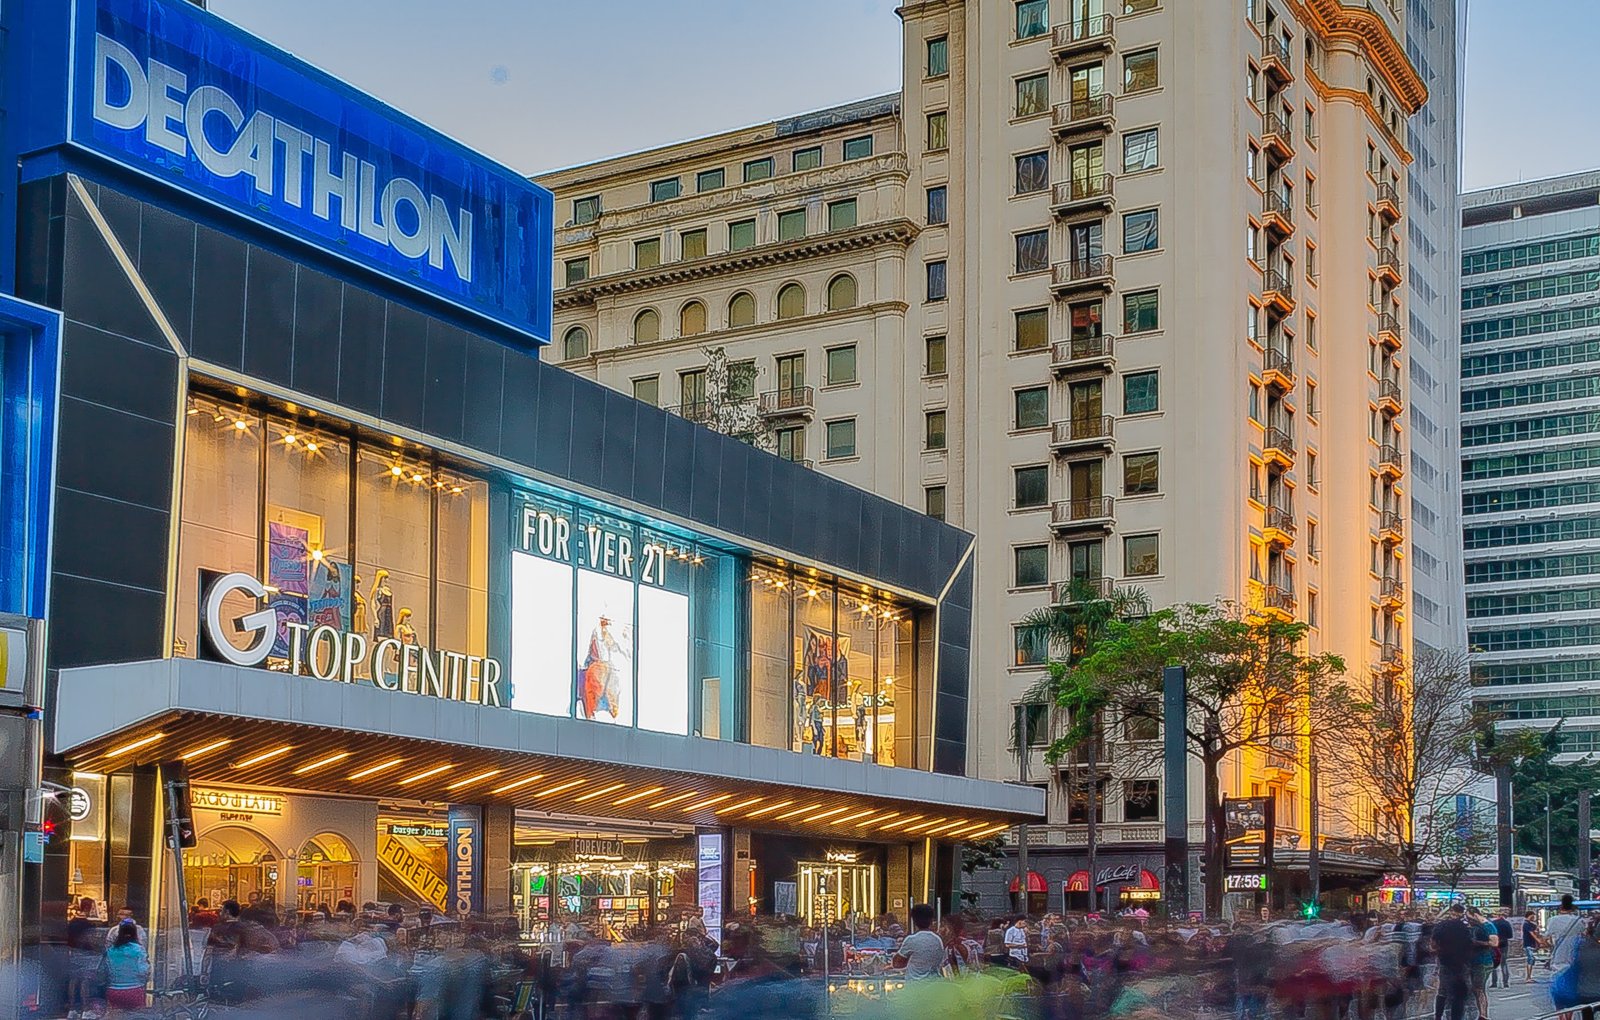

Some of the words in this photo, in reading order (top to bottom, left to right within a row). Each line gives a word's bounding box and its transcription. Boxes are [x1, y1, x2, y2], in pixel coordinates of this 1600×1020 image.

[93, 32, 472, 282] DECATHLON
[641, 542, 665, 586] 21
[286, 622, 365, 683] TOP
[372, 638, 502, 706] CENTER
[191, 790, 228, 807] BACIO
[244, 794, 283, 811] LATTE
[392, 820, 420, 836] burger
[422, 822, 444, 836] joint
[574, 839, 613, 856] FOREVER
[615, 841, 624, 856] 21
[1226, 874, 1260, 889] 17:56
